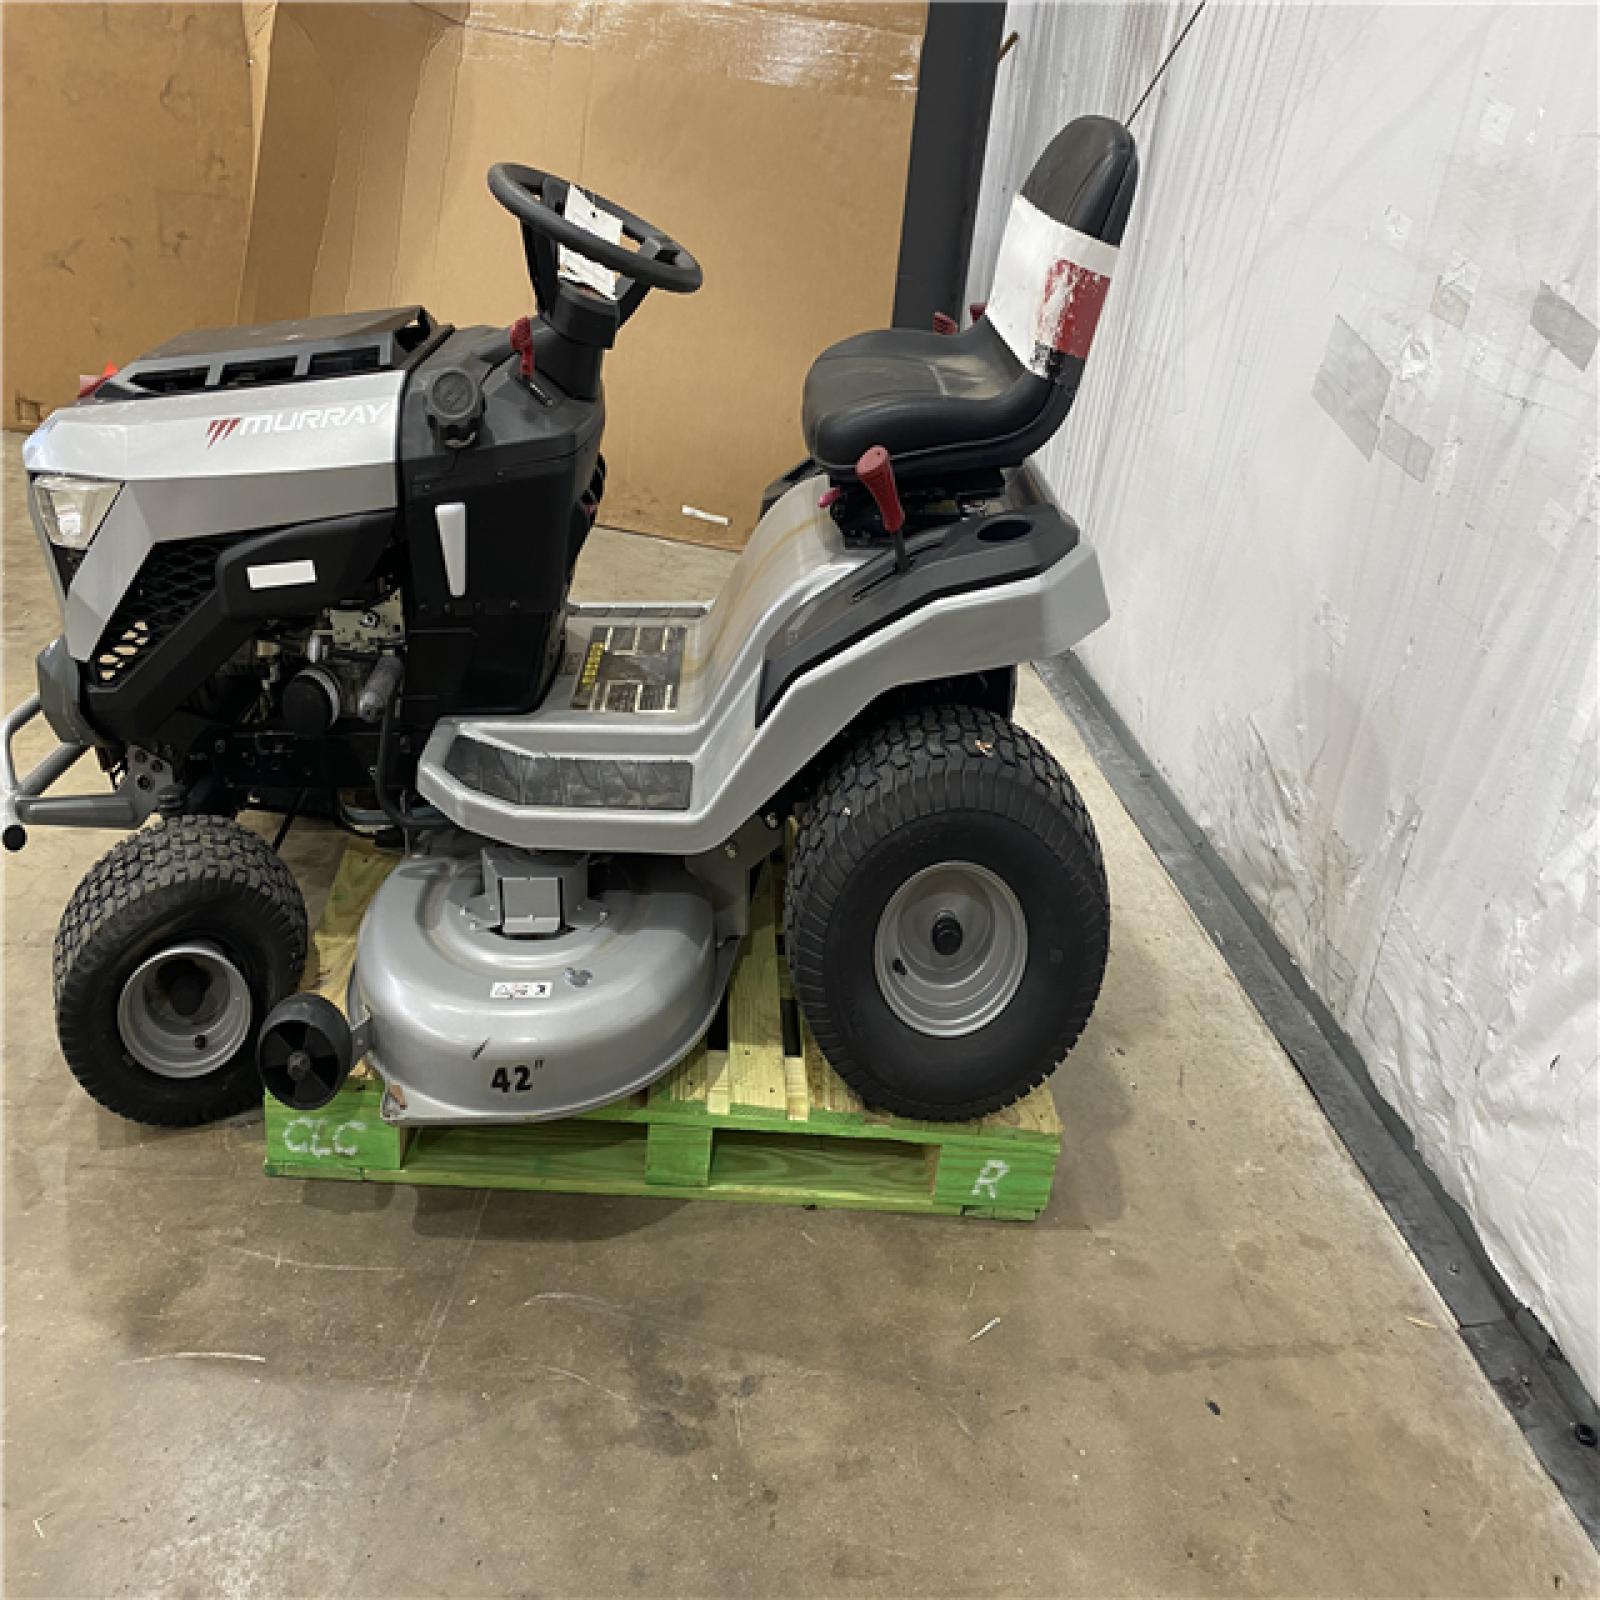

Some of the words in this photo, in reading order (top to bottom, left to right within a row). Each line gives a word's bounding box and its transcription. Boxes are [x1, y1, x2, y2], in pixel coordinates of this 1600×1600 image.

[240, 403, 389, 435] MURRAY
[283, 1117, 366, 1156] CLC
[971, 1159, 1009, 1200] R
